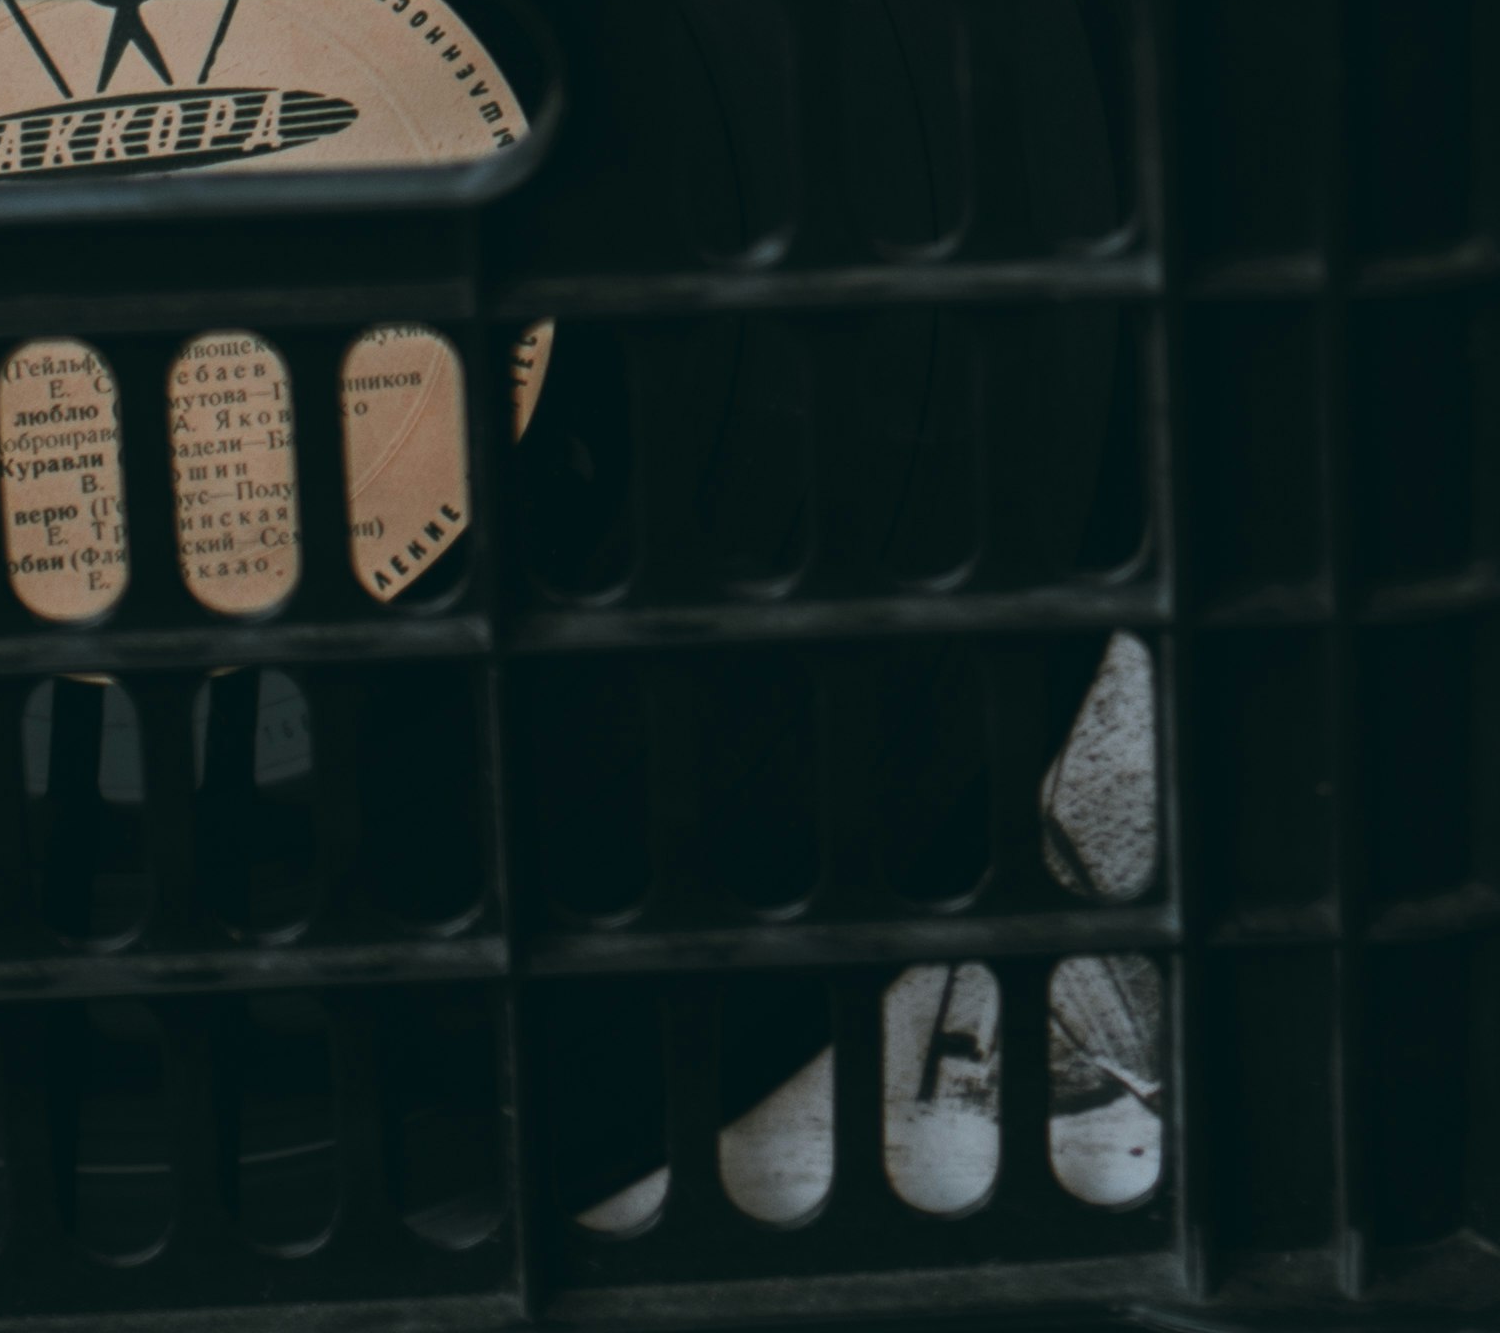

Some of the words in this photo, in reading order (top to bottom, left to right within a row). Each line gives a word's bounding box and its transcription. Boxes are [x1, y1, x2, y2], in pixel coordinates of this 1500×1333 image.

[13, 403, 100, 427] люблю
[81, 473, 105, 494] В.
[13, 504, 79, 527] верю
